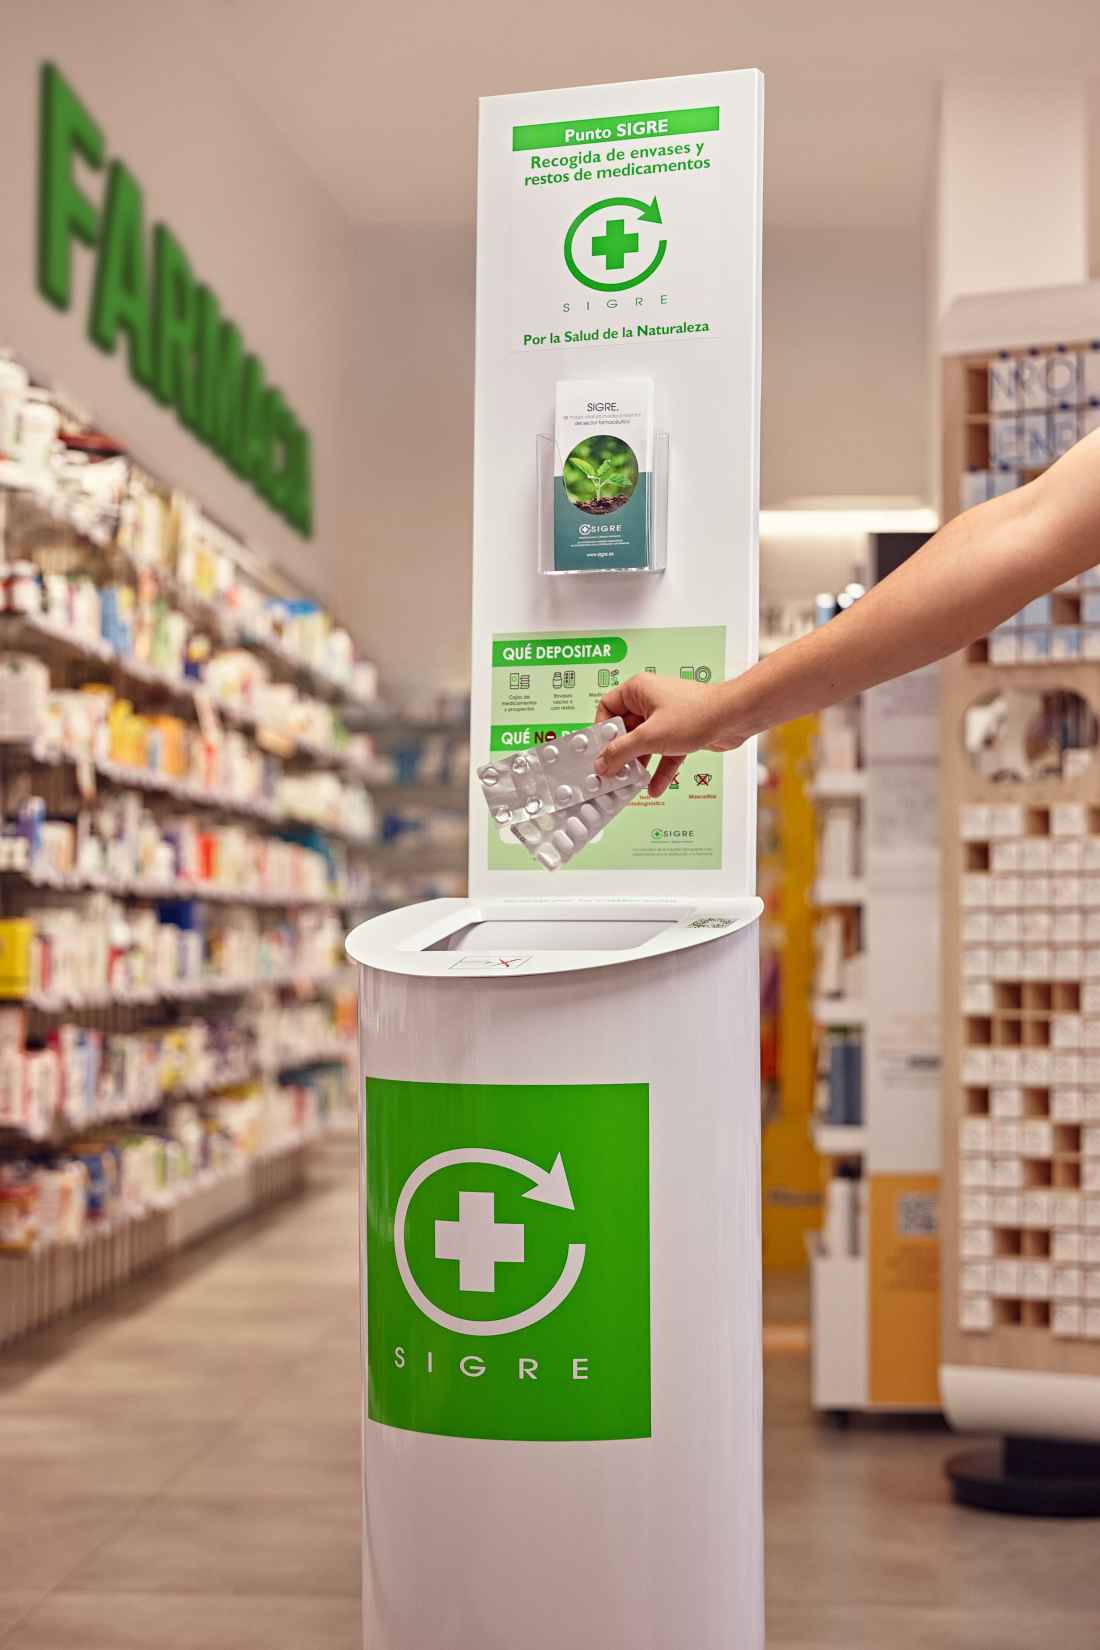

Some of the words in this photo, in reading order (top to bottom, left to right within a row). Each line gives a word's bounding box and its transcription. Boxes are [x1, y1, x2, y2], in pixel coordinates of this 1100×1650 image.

[564, 128, 612, 143] Punto
[616, 119, 669, 137] SIGRE
[531, 150, 601, 169] Recogida
[606, 148, 625, 162] de
[630, 143, 690, 159] envases
[695, 142, 705, 157] y
[524, 169, 569, 186] restos
[574, 167, 592, 181] de
[596, 158, 711, 179] medicamentos
[562, 294, 669, 313] SIGRE
[523, 333, 547, 346] Por
[550, 332, 561, 344] la
[564, 328, 600, 343] Salud
[602, 327, 618, 340] de
[622, 326, 633, 338] la
[636, 322, 710, 337] Naturaleza
[591, 524, 622, 533] SIGRE
[502, 643, 532, 661] QUÉ
[536, 643, 611, 660] DEPOSITAR
[501, 728, 530, 745] QUÉ
[663, 830, 695, 838] SIGRE
[394, 1346, 589, 1380] SIGRE
